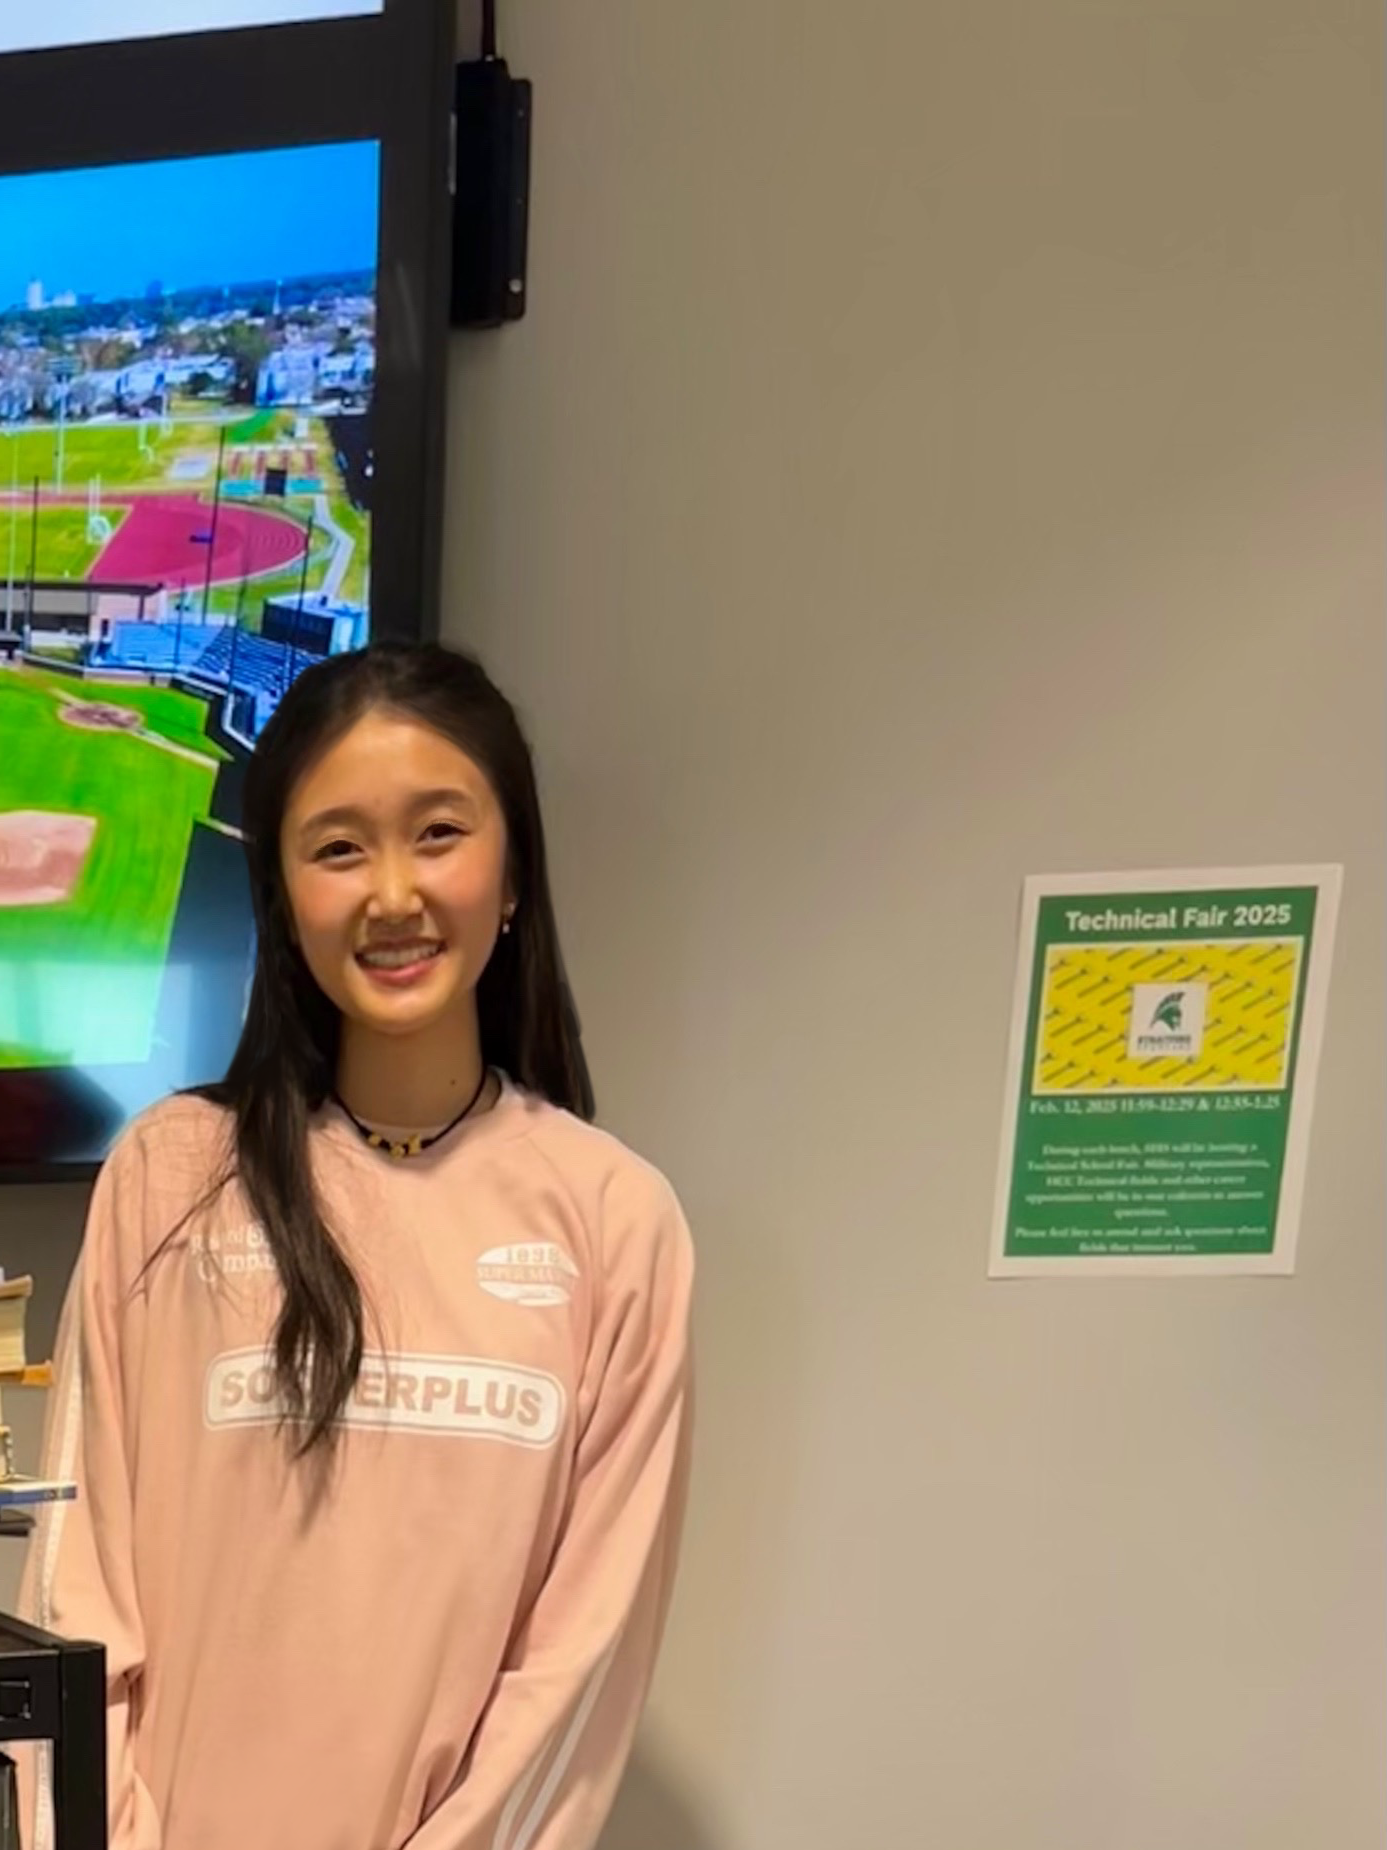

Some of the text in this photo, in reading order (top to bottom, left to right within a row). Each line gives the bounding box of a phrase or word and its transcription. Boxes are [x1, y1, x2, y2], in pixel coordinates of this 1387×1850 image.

[1066, 904, 1292, 932] Technical Fair 2025
[220, 1368, 543, 1427] SOERPLUS
